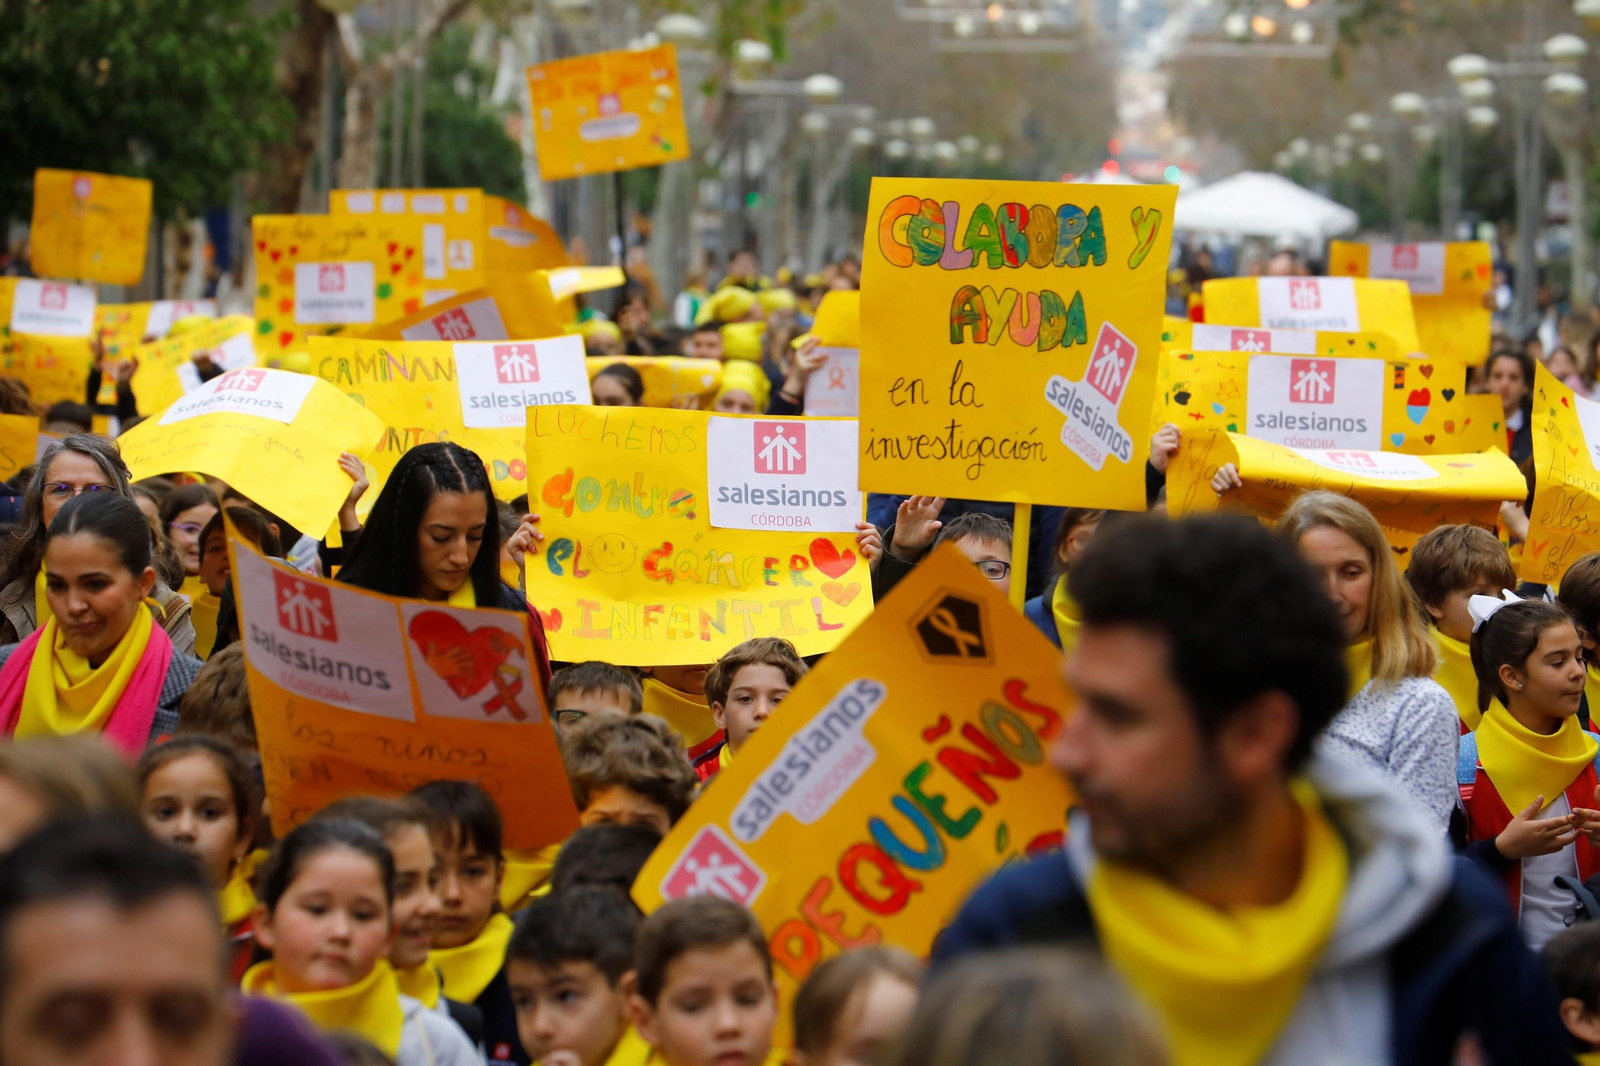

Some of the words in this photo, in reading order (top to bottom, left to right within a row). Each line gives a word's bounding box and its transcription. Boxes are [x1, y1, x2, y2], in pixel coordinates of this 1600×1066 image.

[878, 195, 1107, 270] COLABORA
[949, 285, 1088, 353] AYUDA
[173, 392, 285, 415] salesianos
[469, 389, 577, 409] salesianos
[888, 377, 930, 407] en
[949, 359, 984, 408] la
[1046, 379, 1131, 462] salesianos
[1255, 410, 1368, 433] salesianos
[1283, 435, 1337, 450] CÓRDOBA
[865, 418, 1048, 481] investigación
[1062, 424, 1103, 467] CÓRDOBA
[717, 482, 848, 508] salesianos
[750, 513, 813, 528] CÓRDOBA
[572, 597, 845, 642] INFANTIL
[250, 623, 393, 691] salesianos
[736, 679, 882, 841] salesianos
[769, 678, 1066, 984] PEQUEÑOS
